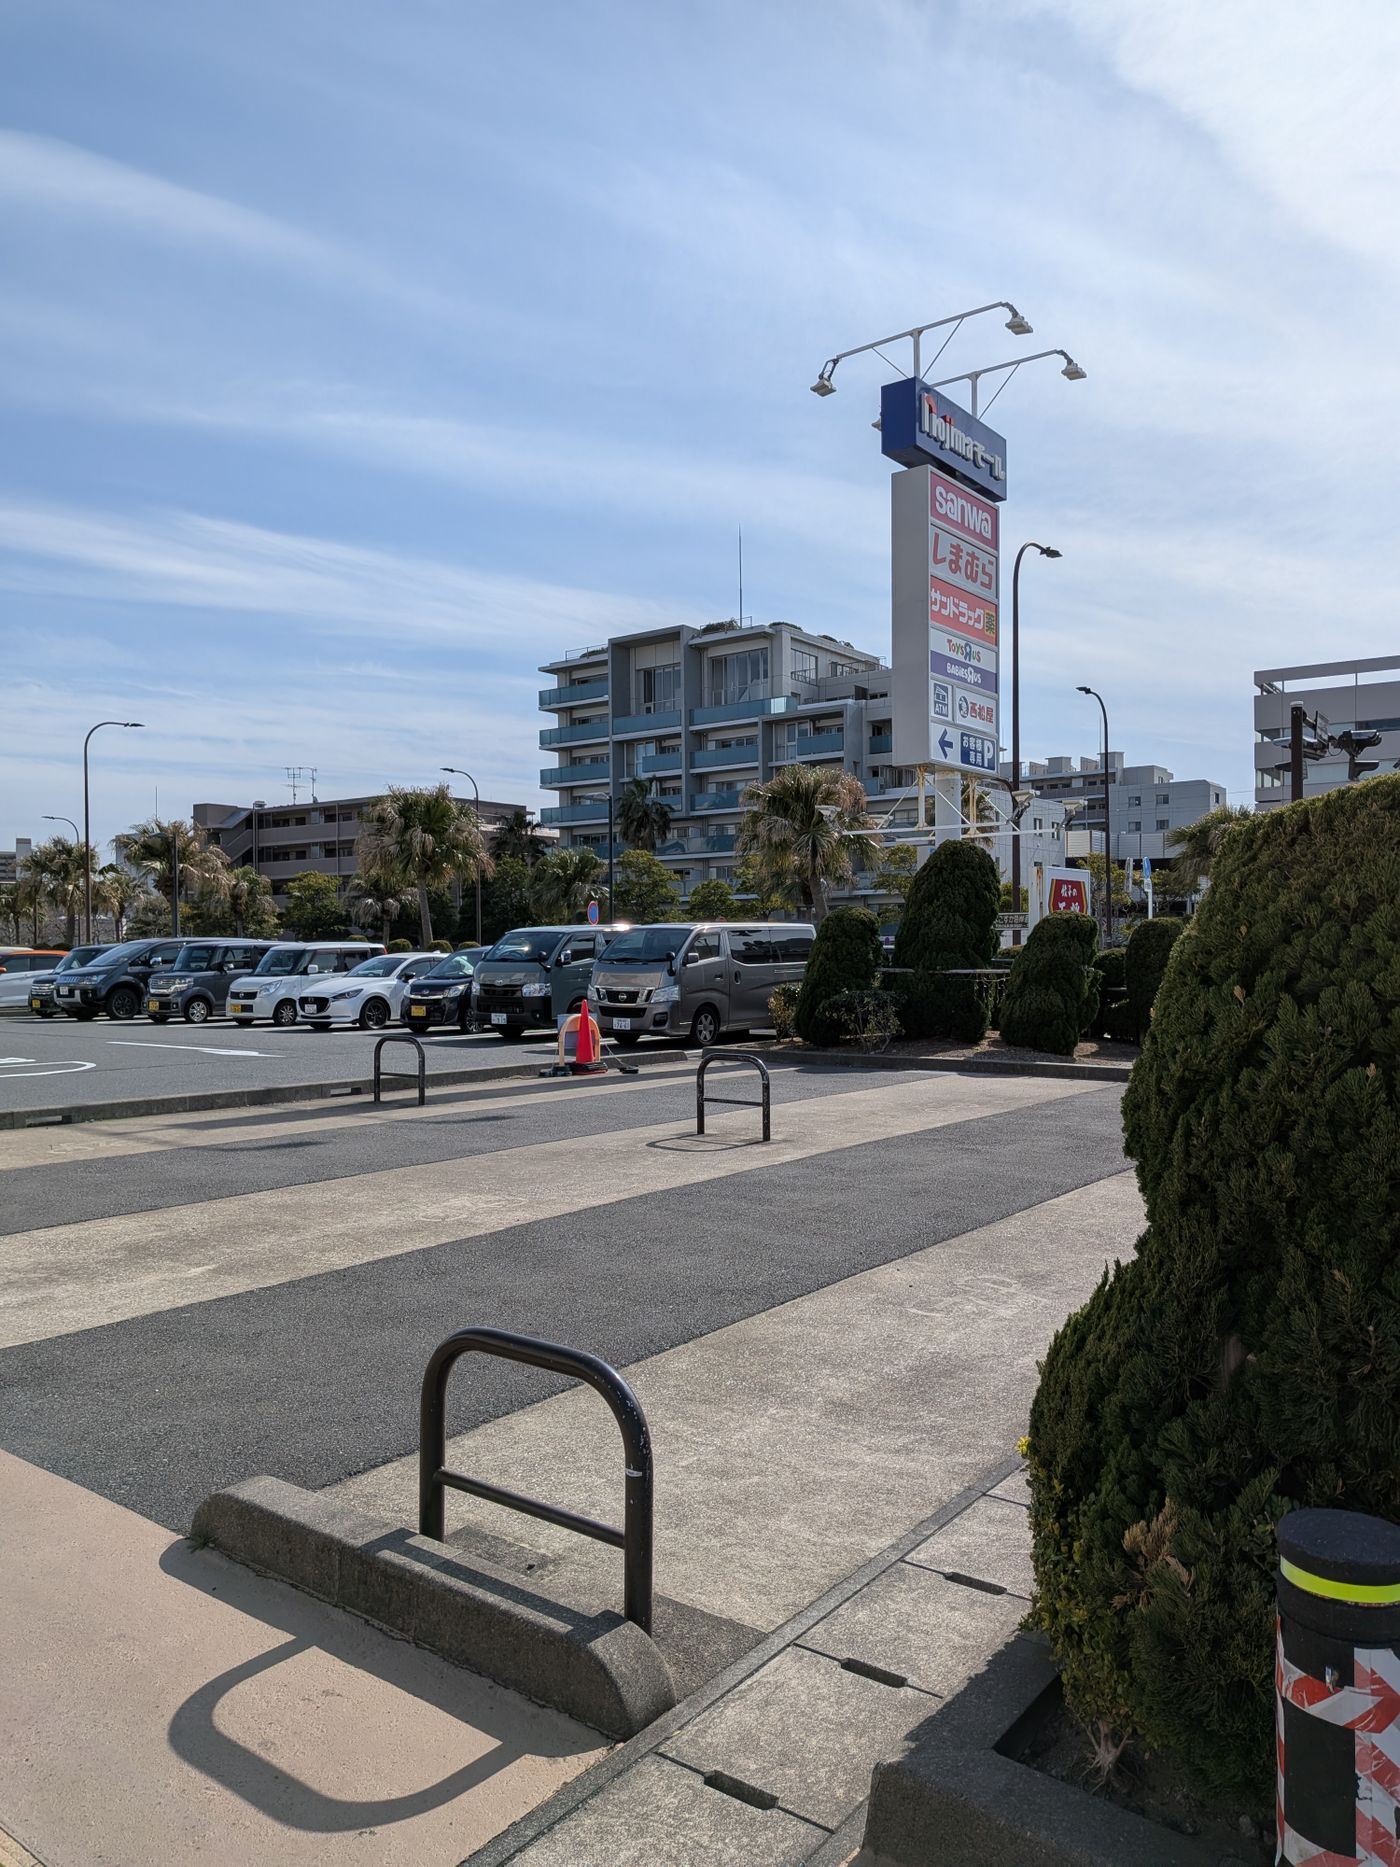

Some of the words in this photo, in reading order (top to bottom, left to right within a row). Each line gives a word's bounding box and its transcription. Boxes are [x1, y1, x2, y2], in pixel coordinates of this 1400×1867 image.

[935, 485, 992, 540] sanwa
[932, 531, 993, 590] しまむら
[931, 588, 984, 630] サンドラッグ
[935, 703, 948, 715] ATM
[969, 701, 993, 724] 西松屋
[983, 740, 994, 768] P
